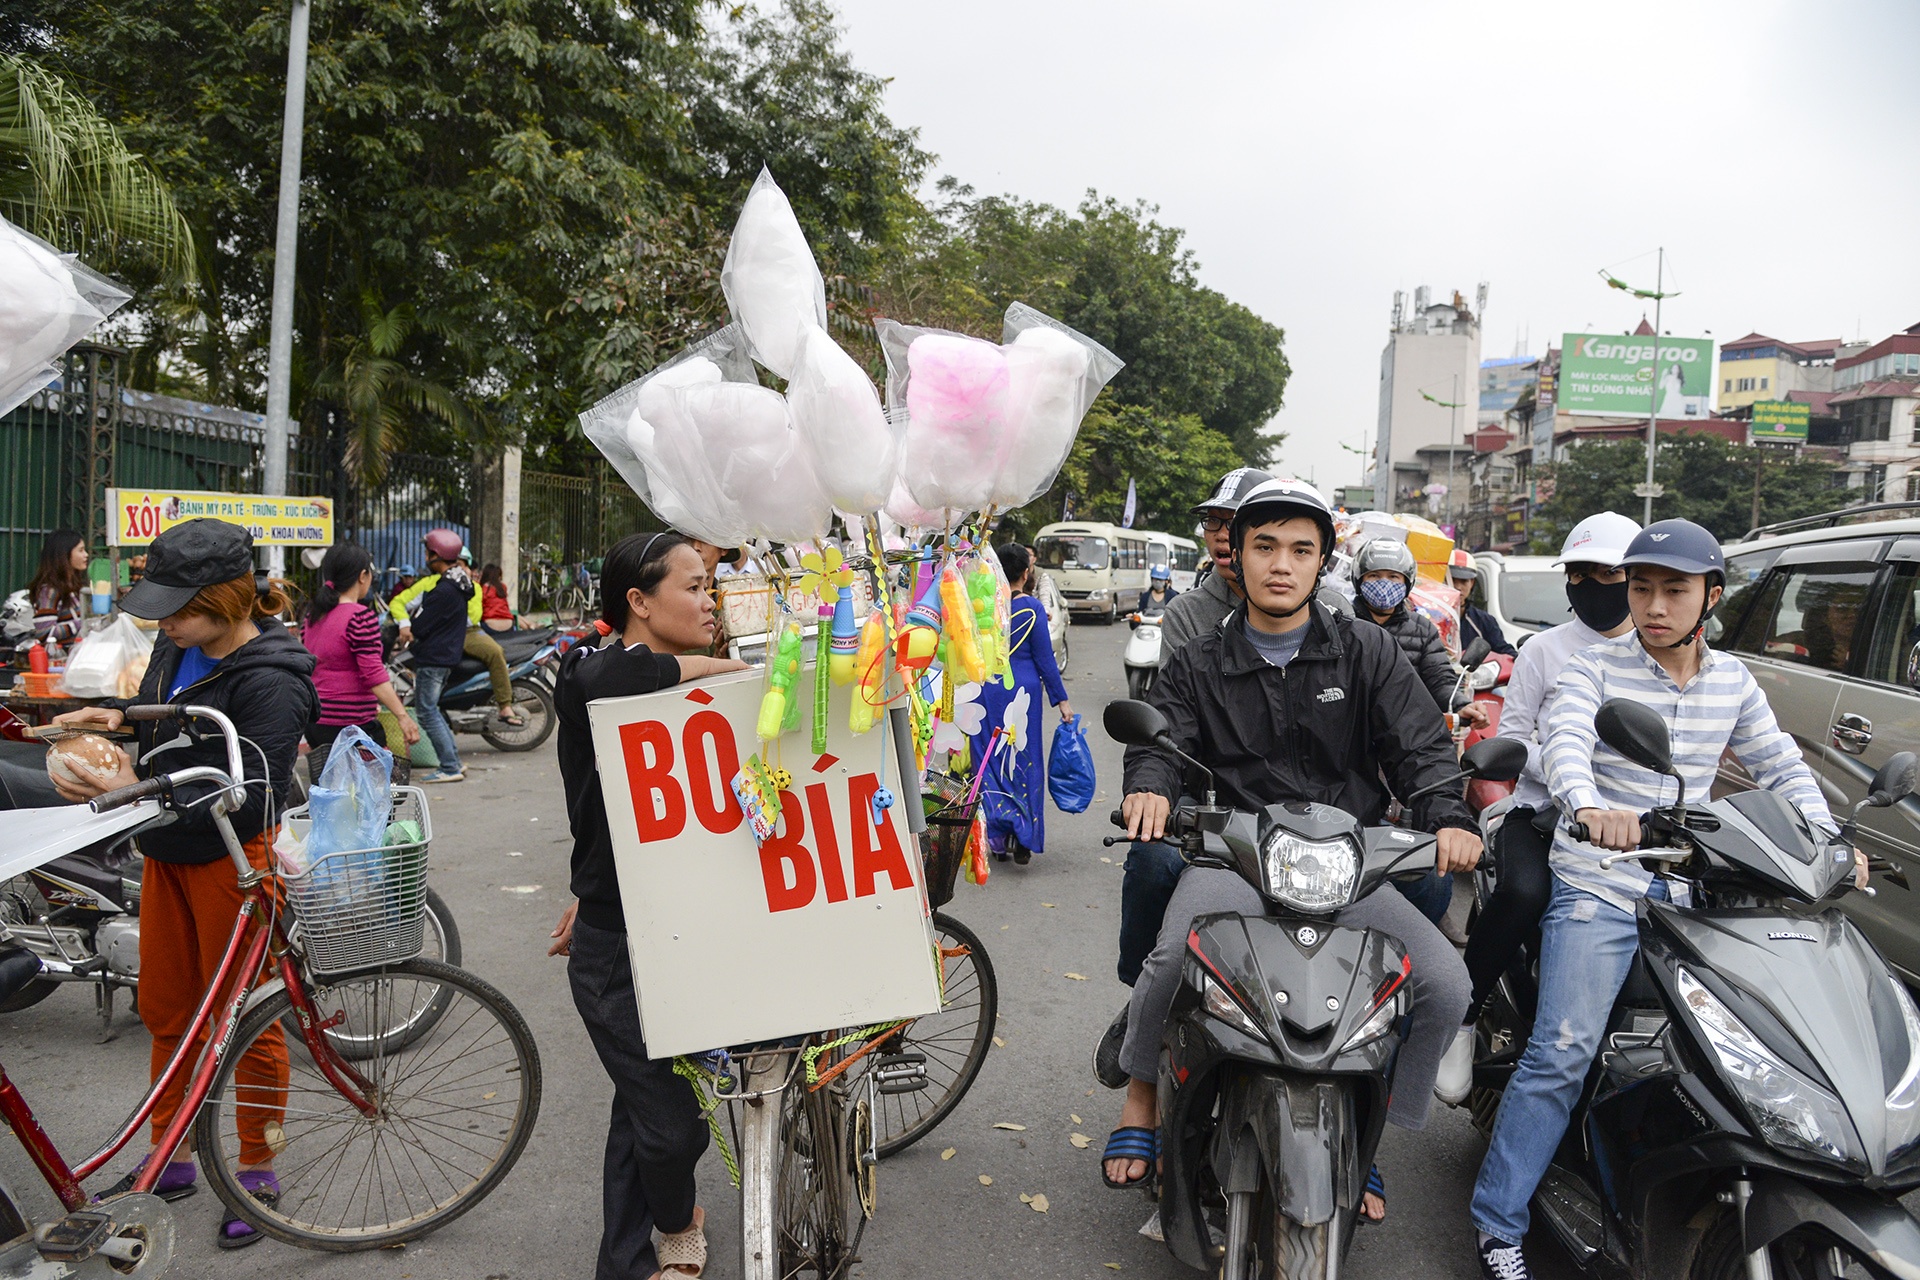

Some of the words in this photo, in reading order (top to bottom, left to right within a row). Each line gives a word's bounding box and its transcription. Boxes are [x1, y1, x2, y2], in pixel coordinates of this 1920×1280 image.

[1574, 337, 1698, 364] Kangaroo
[125, 495, 161, 538] XÔI
[179, 500, 204, 515] BÁNH
[222, 503, 233, 515] PA
[271, 527, 295, 540] KHOAI
[618, 687, 745, 845] BÒ
[756, 752, 914, 913] BÍA
[1768, 931, 1818, 943] HONDA
[1673, 1084, 1707, 1128] HONDA
